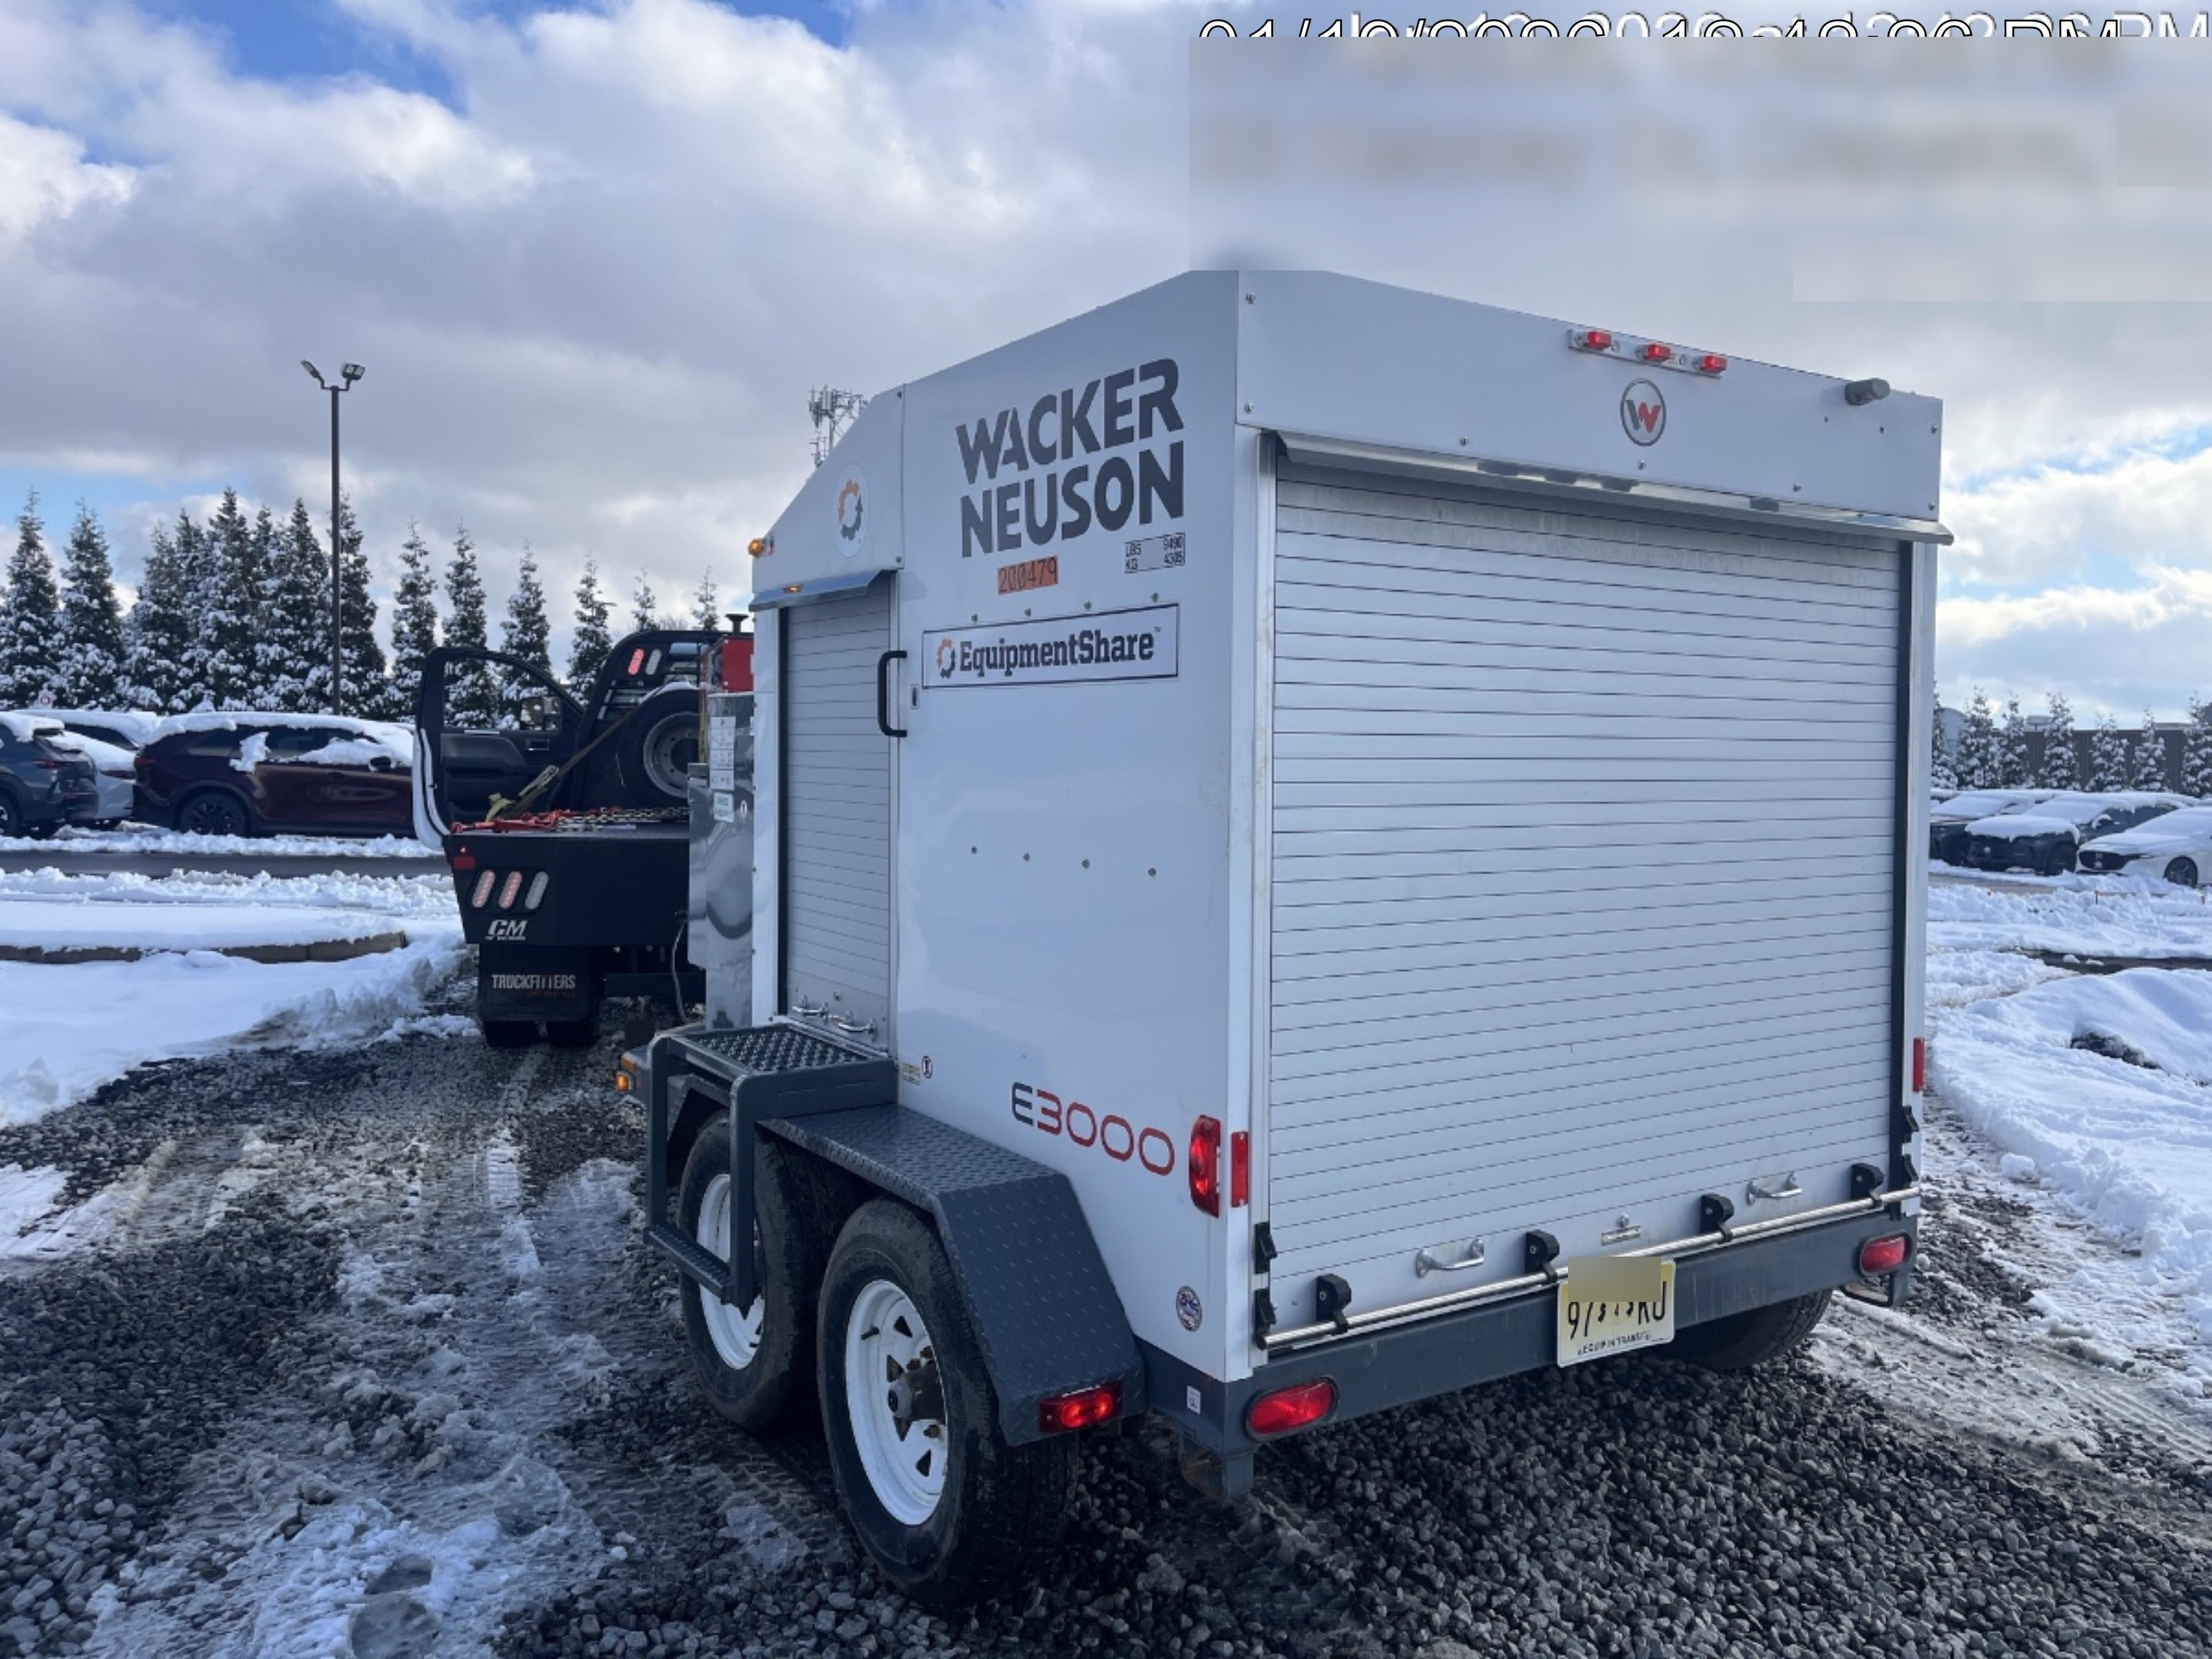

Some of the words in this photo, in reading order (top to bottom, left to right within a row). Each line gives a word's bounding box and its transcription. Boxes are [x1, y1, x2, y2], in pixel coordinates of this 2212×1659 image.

[955, 357, 1185, 485] WACKER
[960, 440, 1184, 558] NEUSON
[998, 555, 1057, 592] 200479
[960, 630, 1155, 677] EquipmentShare
[1012, 1082, 1175, 1176] E3000
